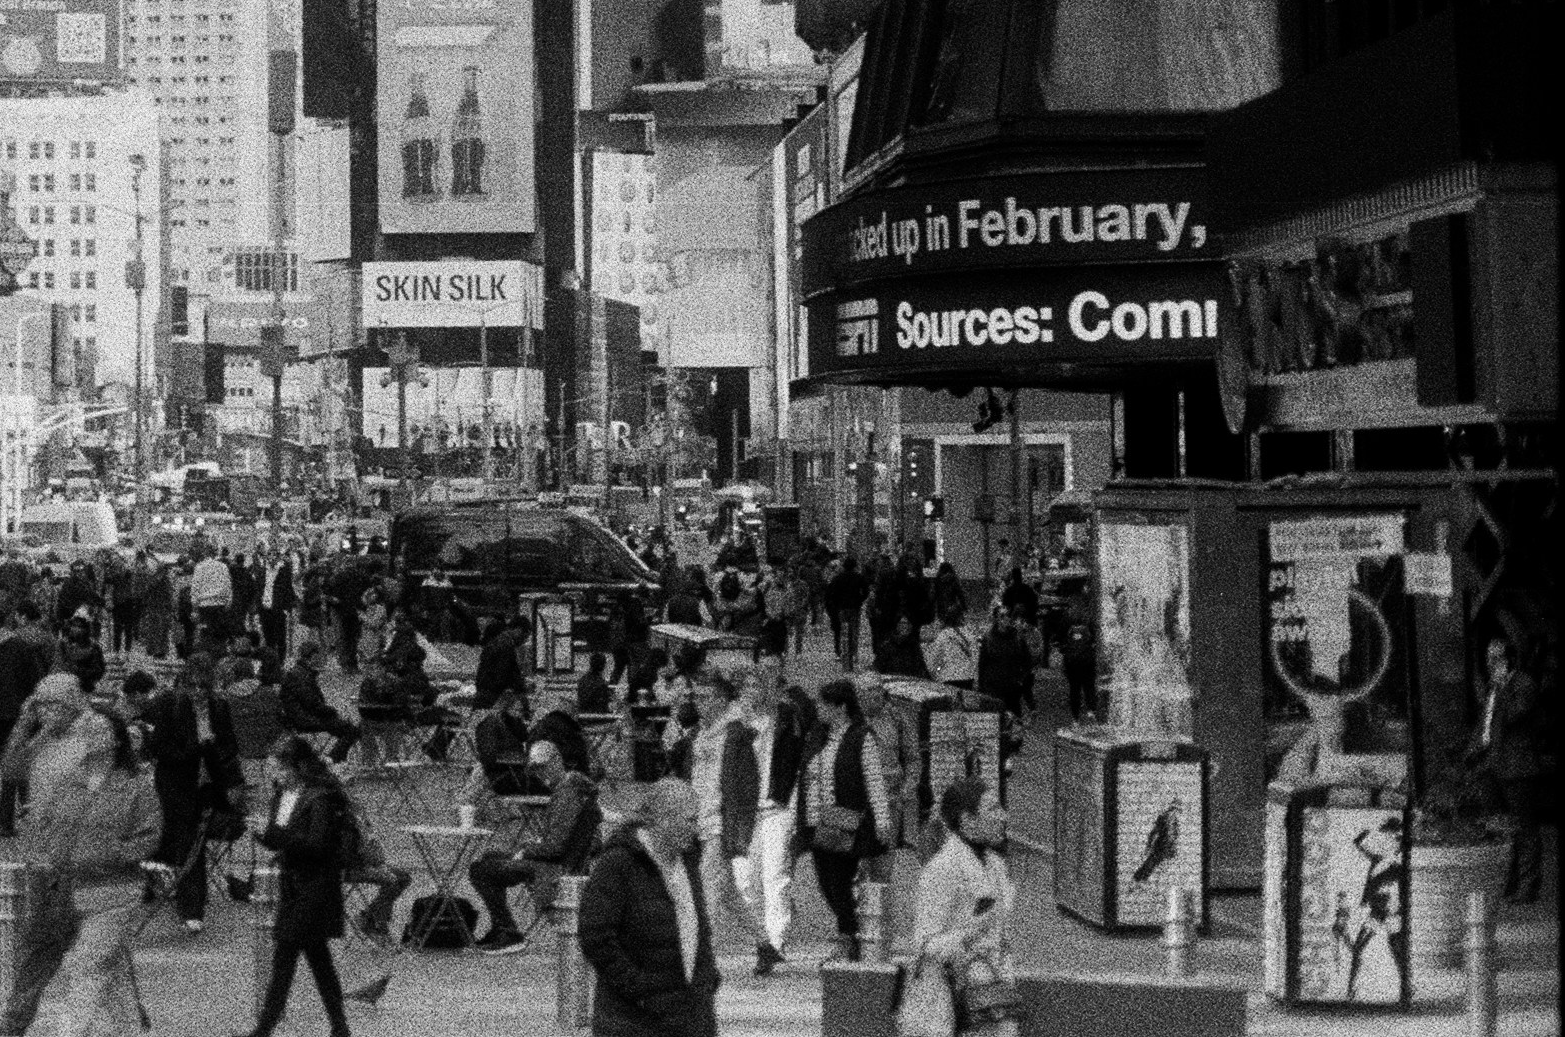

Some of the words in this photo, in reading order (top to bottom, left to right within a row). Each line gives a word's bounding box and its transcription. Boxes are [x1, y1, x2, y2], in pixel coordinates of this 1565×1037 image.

[891, 217, 921, 266] up
[925, 204, 952, 253] in
[957, 196, 1208, 253] February,
[375, 273, 443, 303] SKIN
[448, 273, 508, 303] SILK
[895, 299, 1054, 350] Sources:
